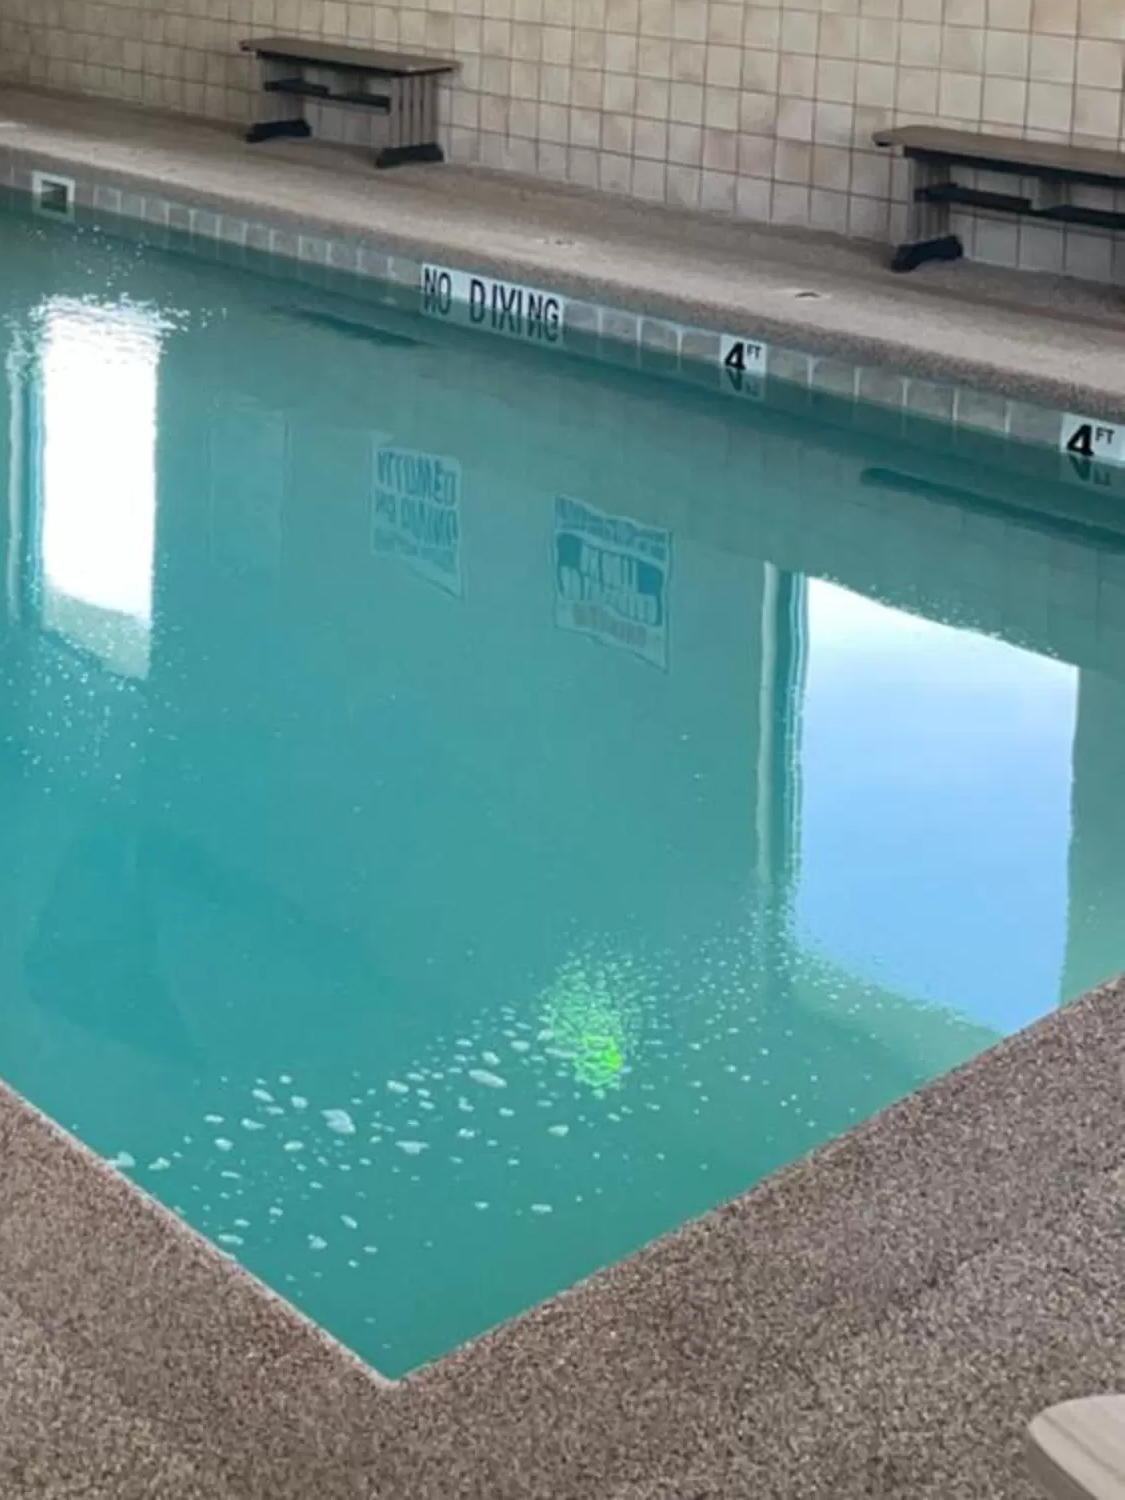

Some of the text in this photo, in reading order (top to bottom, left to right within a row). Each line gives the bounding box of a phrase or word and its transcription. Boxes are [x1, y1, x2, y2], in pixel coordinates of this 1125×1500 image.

[423, 266, 452, 310] NO
[724, 340, 747, 370] 4
[1066, 423, 1116, 457] 4 FT
